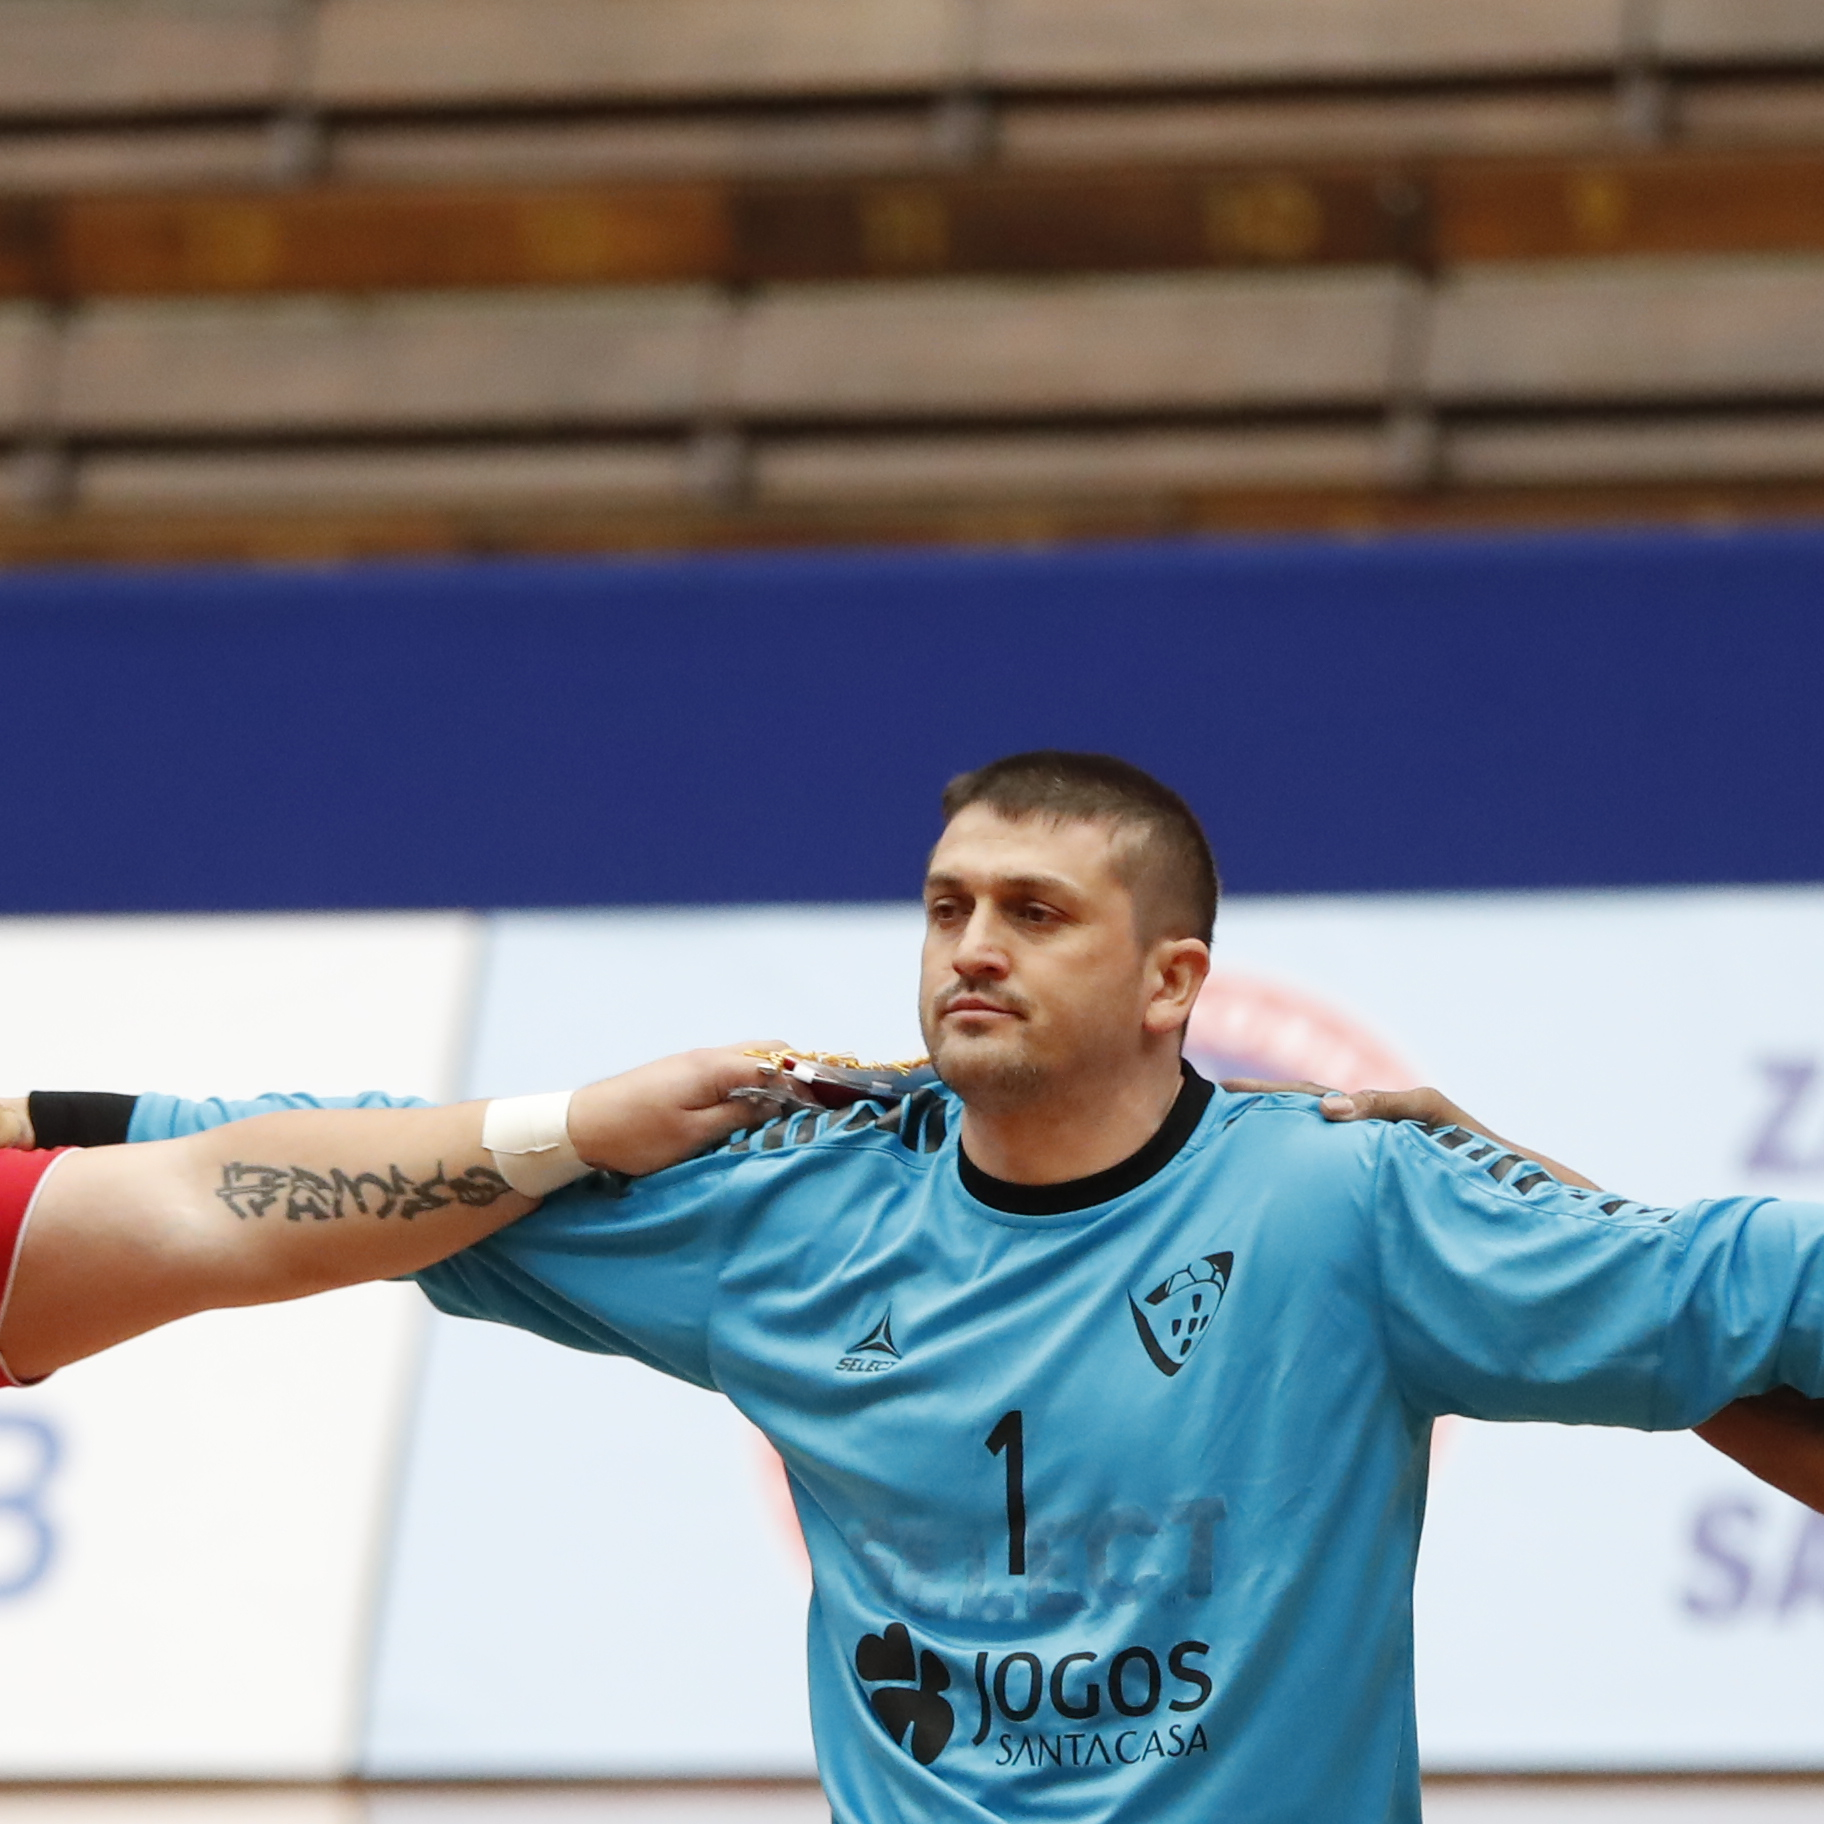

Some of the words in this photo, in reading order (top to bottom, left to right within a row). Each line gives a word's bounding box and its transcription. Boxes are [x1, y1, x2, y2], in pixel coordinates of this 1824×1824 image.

[834, 1357, 903, 1372] SELECT
[984, 1410, 1026, 1576] 1
[972, 1640, 1213, 1746] JOGOS
